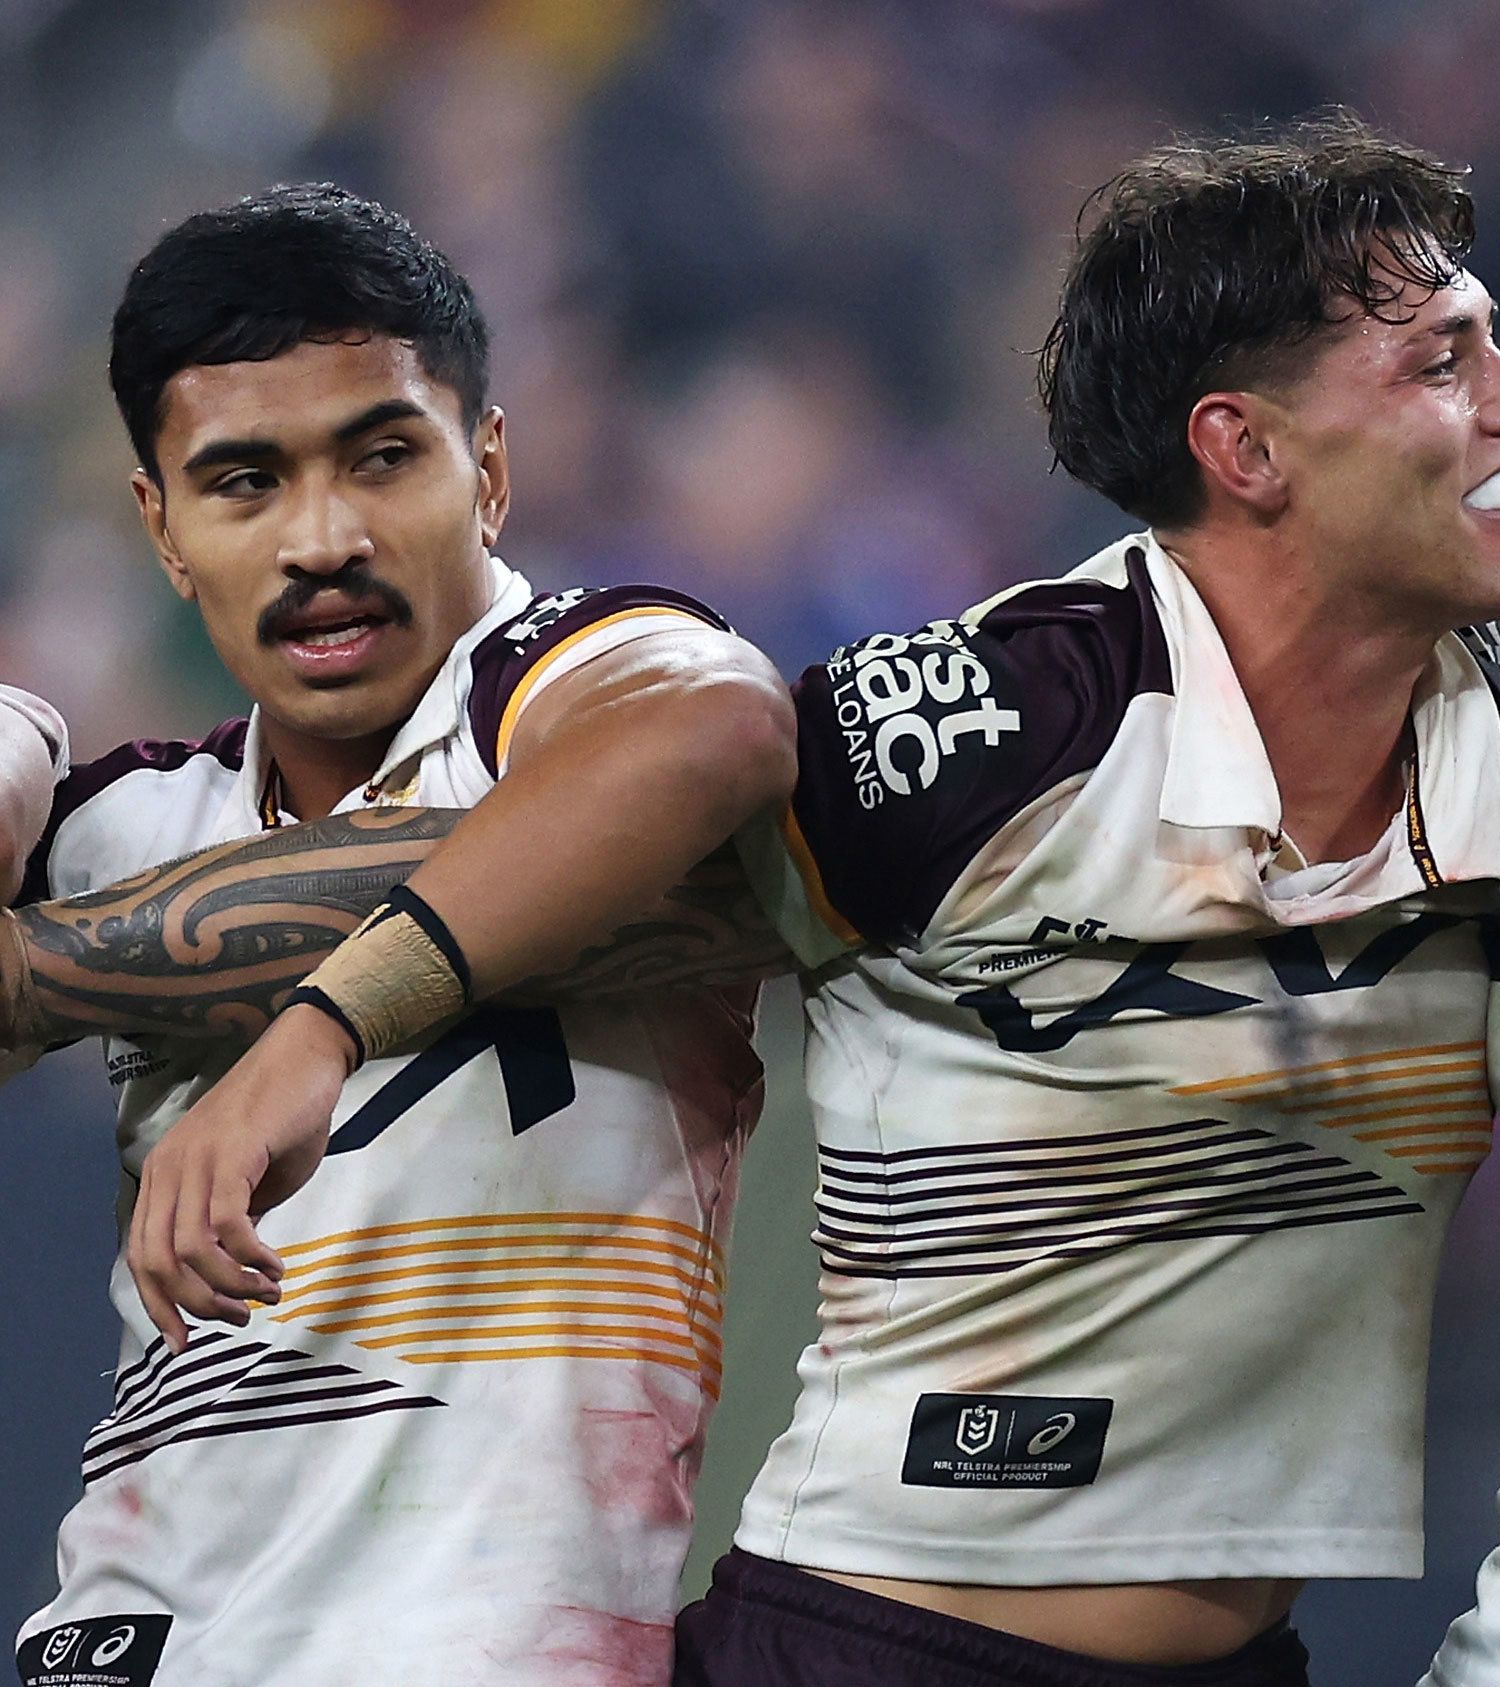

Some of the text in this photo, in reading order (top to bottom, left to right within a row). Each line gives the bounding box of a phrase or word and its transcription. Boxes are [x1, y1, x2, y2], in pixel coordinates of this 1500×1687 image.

[833, 680, 884, 810] LOANS
[956, 1462, 1000, 1471] TELSTRA
[953, 1472, 1048, 1481] OFFICIAL PRODUCT
